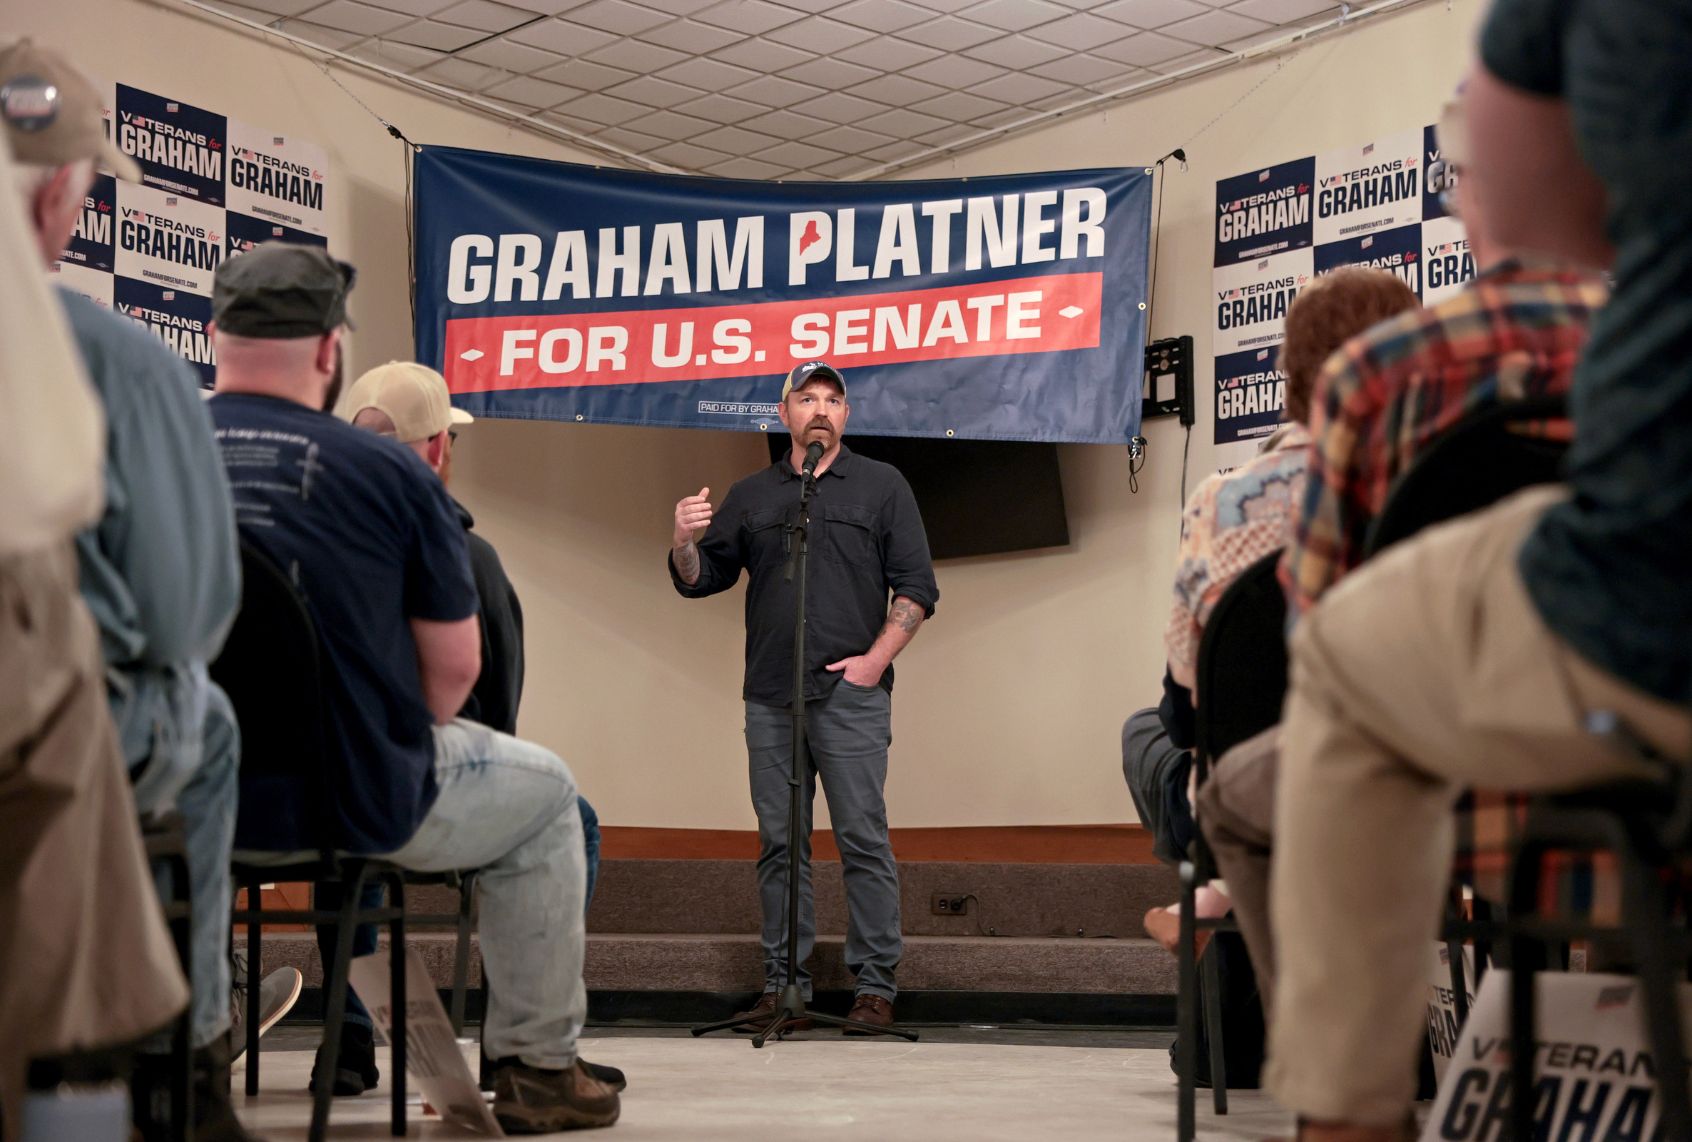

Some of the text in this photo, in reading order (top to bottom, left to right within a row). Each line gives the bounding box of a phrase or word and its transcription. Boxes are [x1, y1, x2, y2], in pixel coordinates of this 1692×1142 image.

[121, 110, 207, 146] VTERANS
[208, 138, 222, 150] for
[120, 123, 222, 182] GRAHAM
[231, 144, 310, 177] VTERANS
[230, 157, 323, 211] GRAHAM
[1319, 159, 1402, 188] VTERANS
[97, 200, 112, 212] for
[1220, 185, 1296, 213] VTERANS
[1318, 168, 1417, 219] GRAHAM
[121, 206, 205, 239] VTERANS
[207, 230, 220, 242] for
[1219, 193, 1310, 243] GRAHAM
[120, 219, 220, 272] GRAHAM
[447, 187, 1107, 305] GRAHAM PLATNER
[1403, 250, 1418, 263] for
[1218, 276, 1294, 301] VTERANS
[1427, 251, 1476, 290] GRA
[118, 302, 202, 332] VTERANS
[499, 290, 1043, 376] FOR U.S. SENATE
[1218, 369, 1289, 389] VTERAN
[700, 402, 779, 414] PAID FOR BY GRAHA
[1217, 380, 1287, 420] GRAHA
